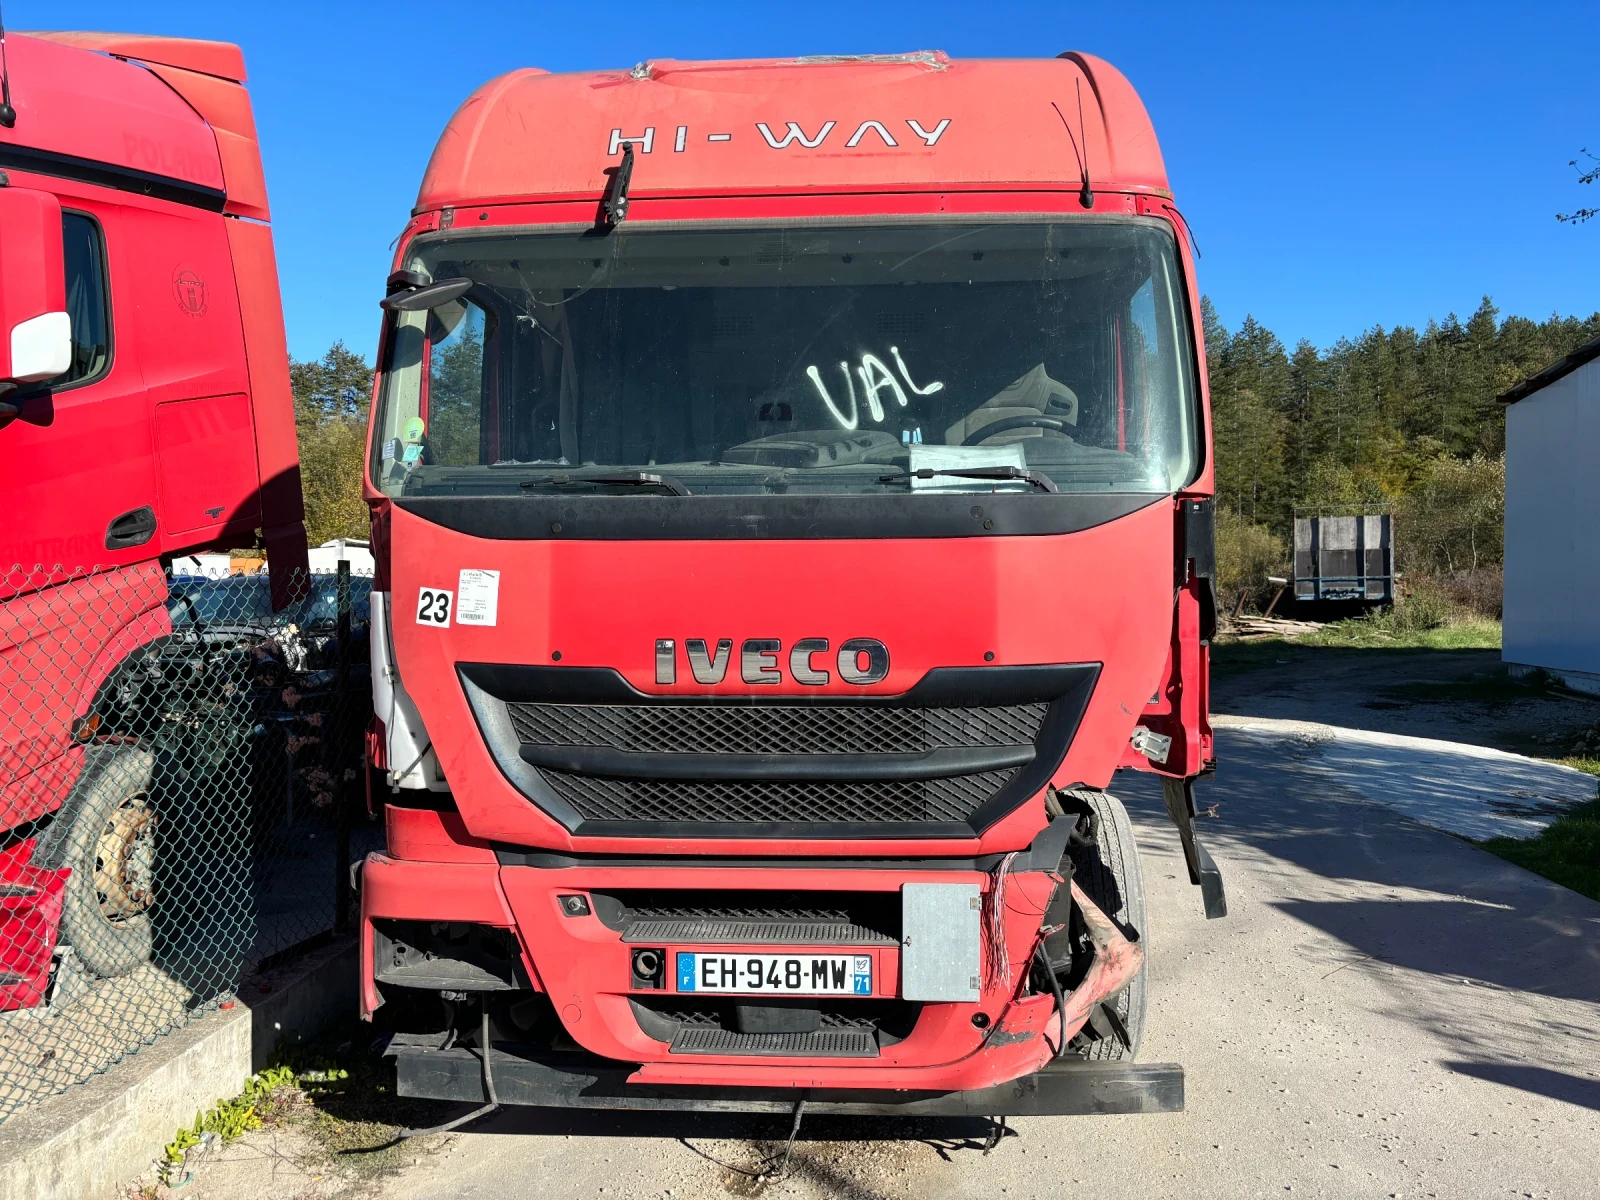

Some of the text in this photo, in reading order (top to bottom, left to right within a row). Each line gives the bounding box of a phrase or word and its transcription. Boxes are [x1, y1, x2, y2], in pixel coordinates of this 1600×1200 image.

[607, 119, 952, 156] HI-WAY
[806, 346, 943, 429] VAL
[418, 590, 450, 624] 23
[655, 638, 890, 685] IVECO
[683, 958, 870, 992] F EH-948-MW 71
